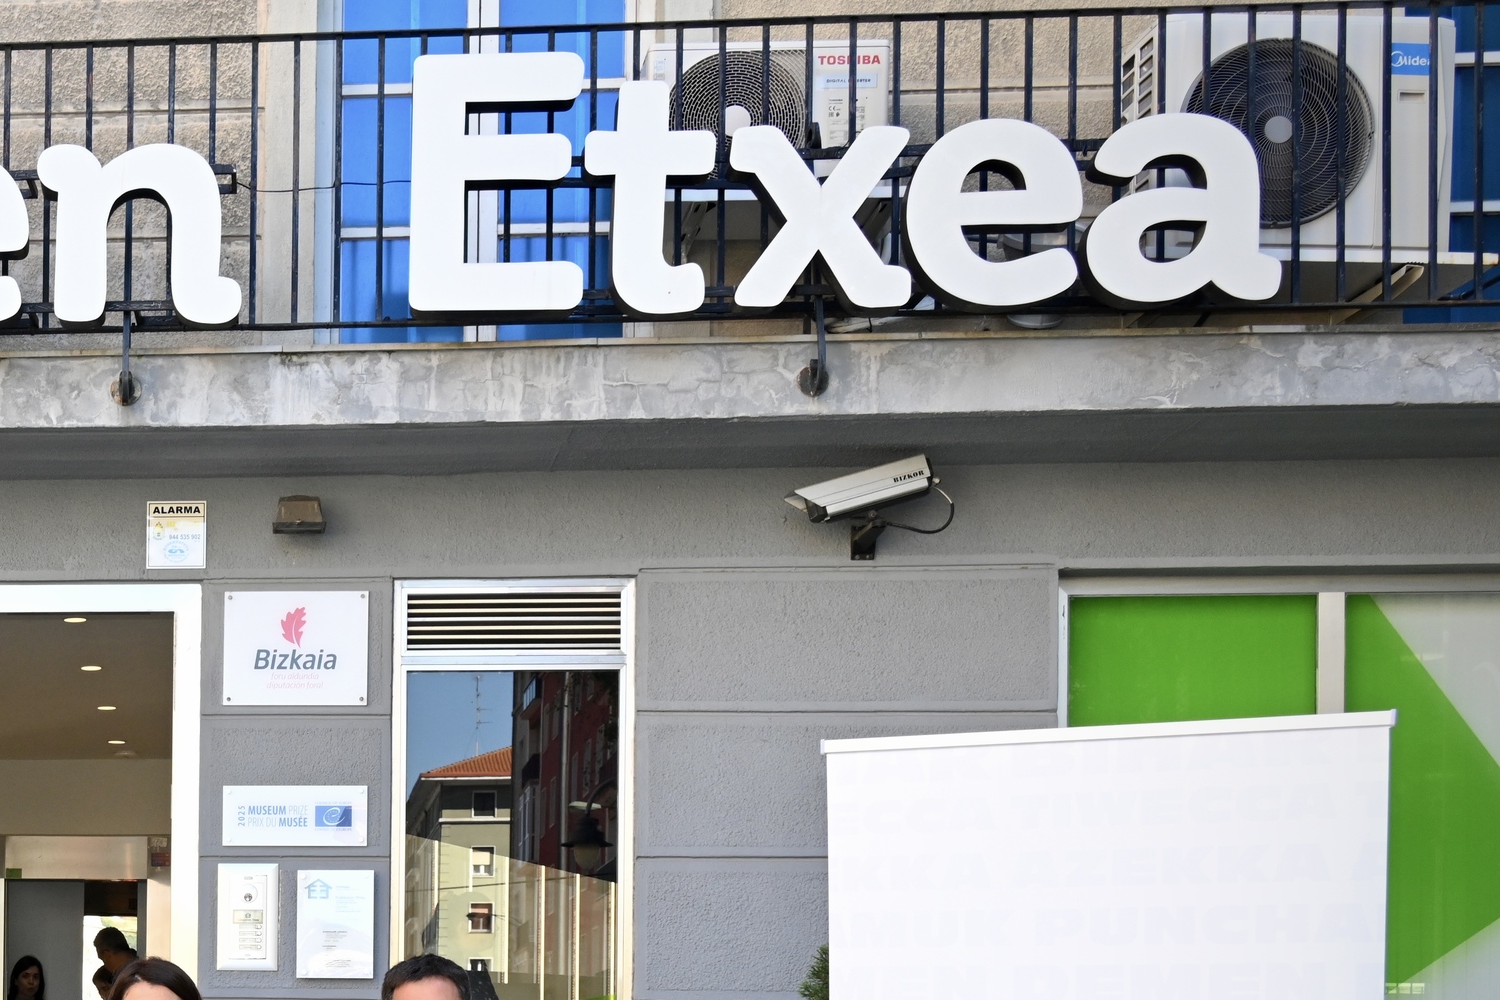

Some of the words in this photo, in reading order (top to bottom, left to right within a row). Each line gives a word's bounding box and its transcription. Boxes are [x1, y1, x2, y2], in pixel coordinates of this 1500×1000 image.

[409, 52, 1282, 315] Etxea
[893, 470, 924, 483] BIZKOR
[153, 506, 201, 514] ALARMA
[254, 649, 337, 670] Bizkaia
[271, 672, 286, 680] foru
[287, 672, 319, 680] aldundia
[306, 680, 323, 689] foral
[248, 805, 286, 815] MUSEUM
[288, 805, 308, 815] PRIZE
[248, 817, 265, 827] PRIX
[265, 817, 276, 827] DU
[278, 816, 308, 827] MUSÉE
